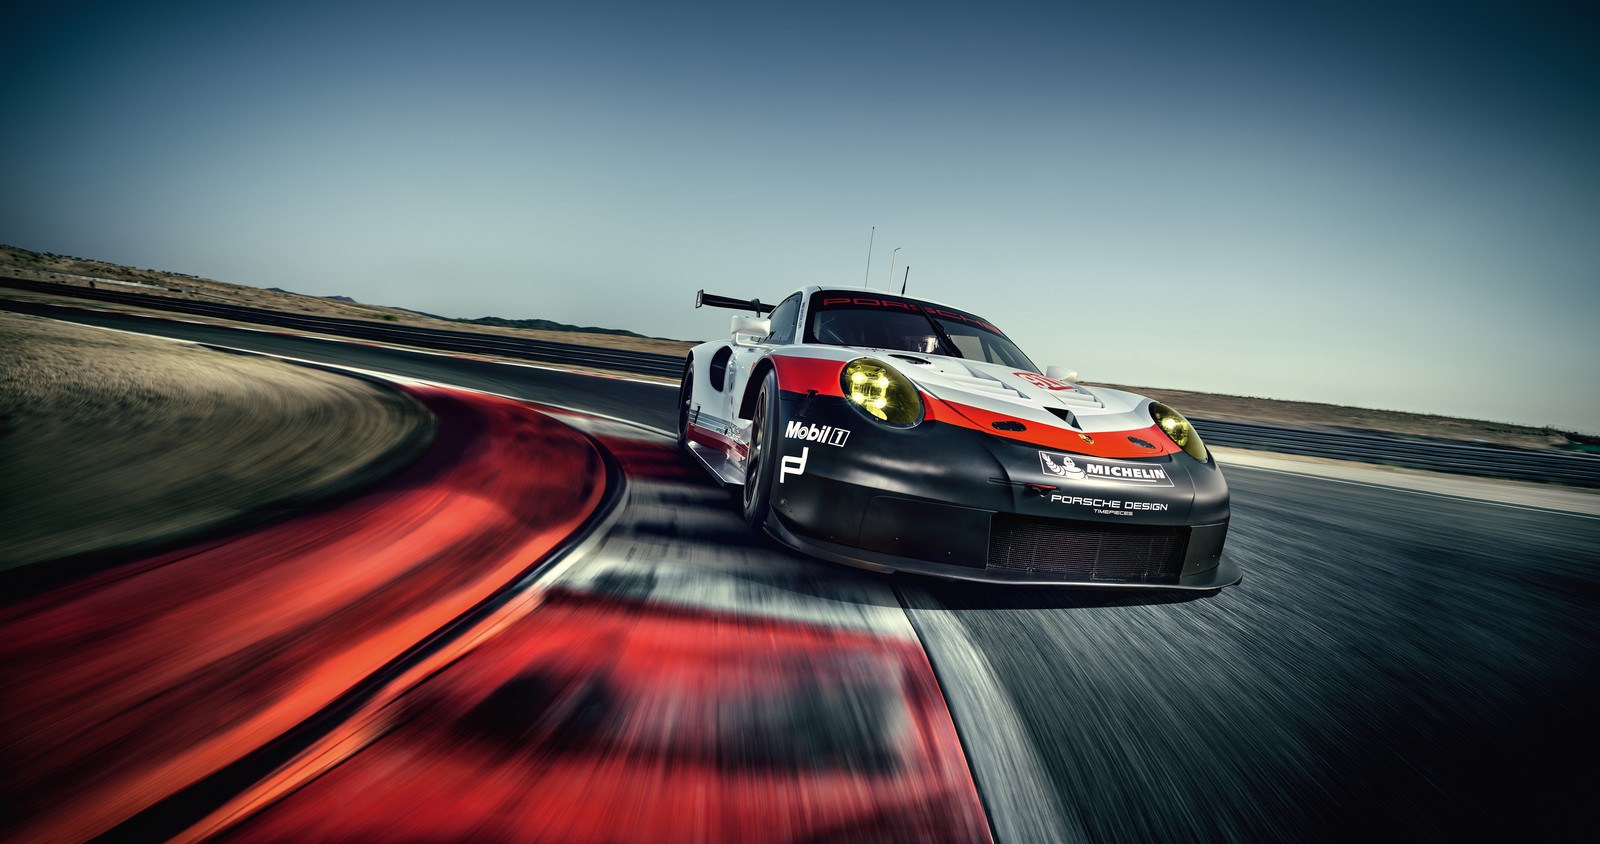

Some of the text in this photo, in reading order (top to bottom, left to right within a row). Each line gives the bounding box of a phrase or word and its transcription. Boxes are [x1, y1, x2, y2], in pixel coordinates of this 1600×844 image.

[823, 298, 1004, 335] PORSCHE
[785, 420, 832, 443] Mobil
[1086, 463, 1166, 479] MICHELIN
[1051, 494, 1168, 511] PORSCHE DESIGN
[1093, 508, 1133, 516] TIMEPIECES
